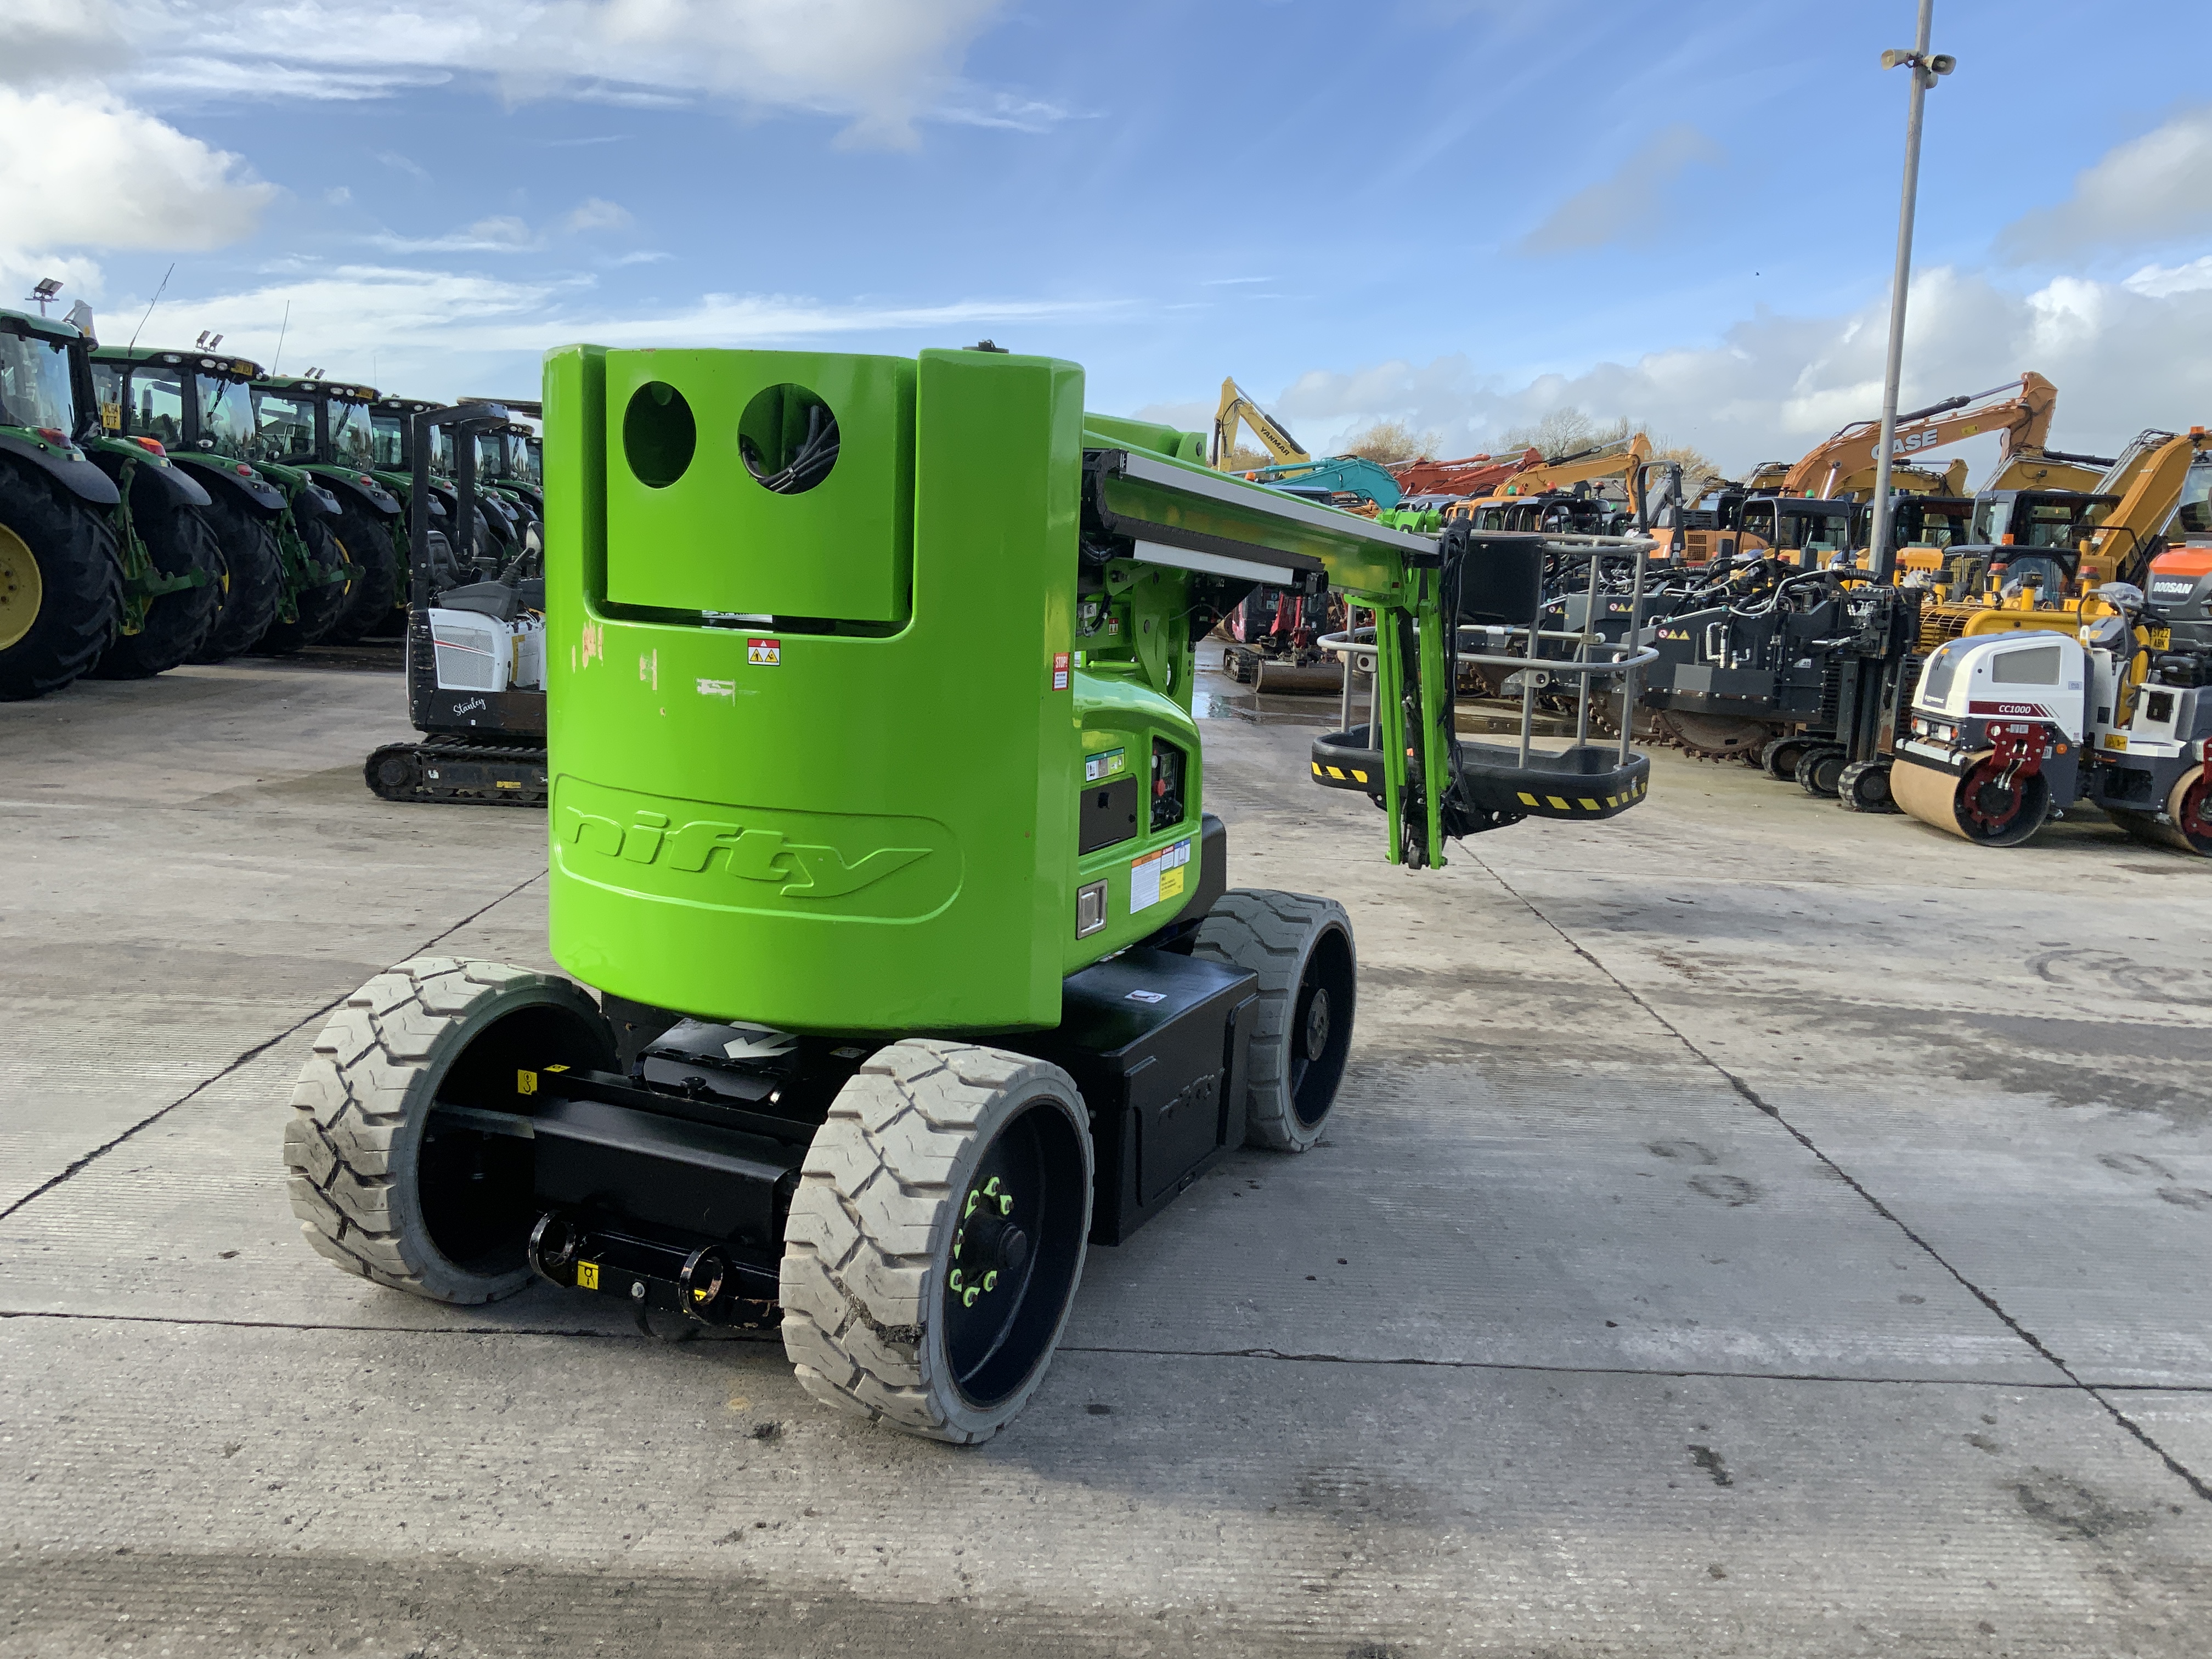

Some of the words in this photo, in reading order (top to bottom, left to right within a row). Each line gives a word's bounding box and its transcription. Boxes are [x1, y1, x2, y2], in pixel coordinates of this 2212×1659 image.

[1261, 426, 1290, 456] YANMAR
[1870, 428, 1938, 460] CASE
[2153, 582, 2193, 594] DOOSAN
[1056, 656, 1068, 668] STOP!
[453, 697, 486, 716] Stanley
[1999, 704, 2032, 714] CC1000
[563, 806, 933, 898] nifty
